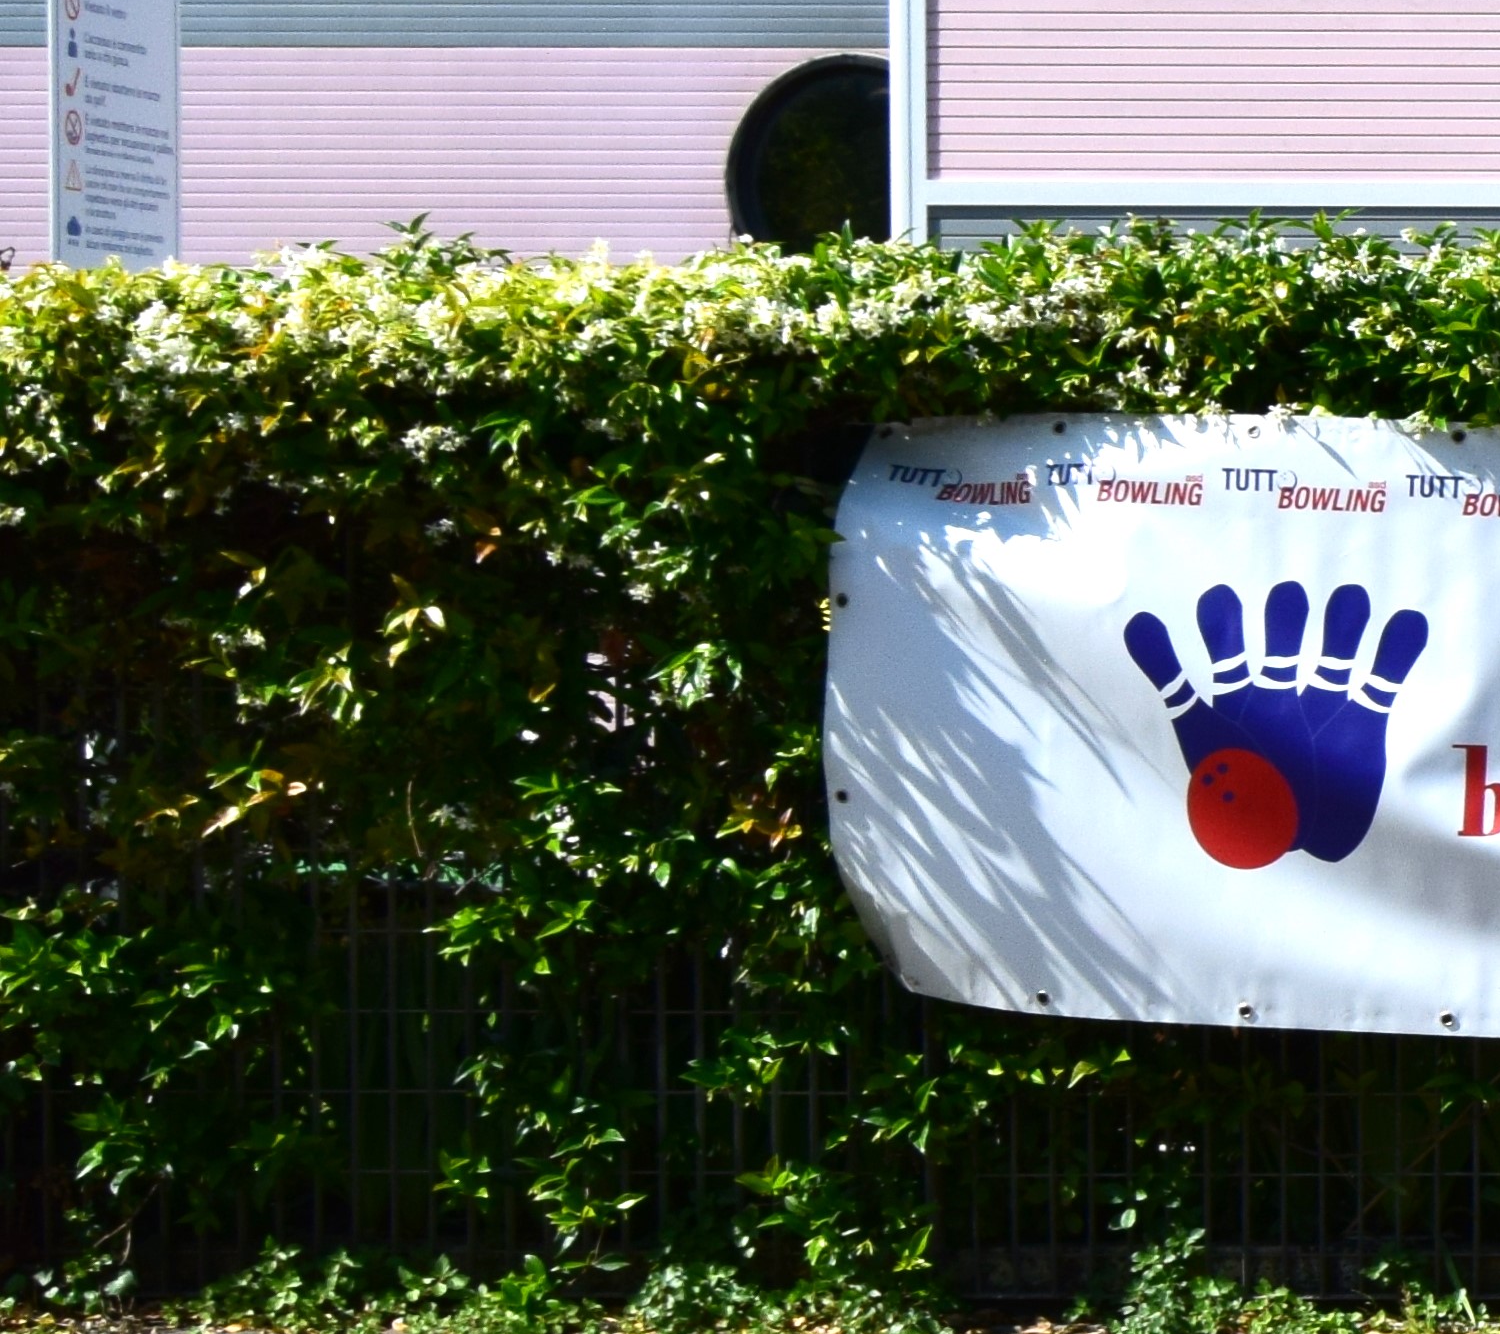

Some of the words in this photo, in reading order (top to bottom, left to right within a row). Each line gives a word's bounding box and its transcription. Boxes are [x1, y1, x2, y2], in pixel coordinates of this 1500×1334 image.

[936, 481, 1031, 505] BOWLING
[1097, 480, 1203, 506] BOWLING
[1277, 487, 1386, 513] BOWLING
